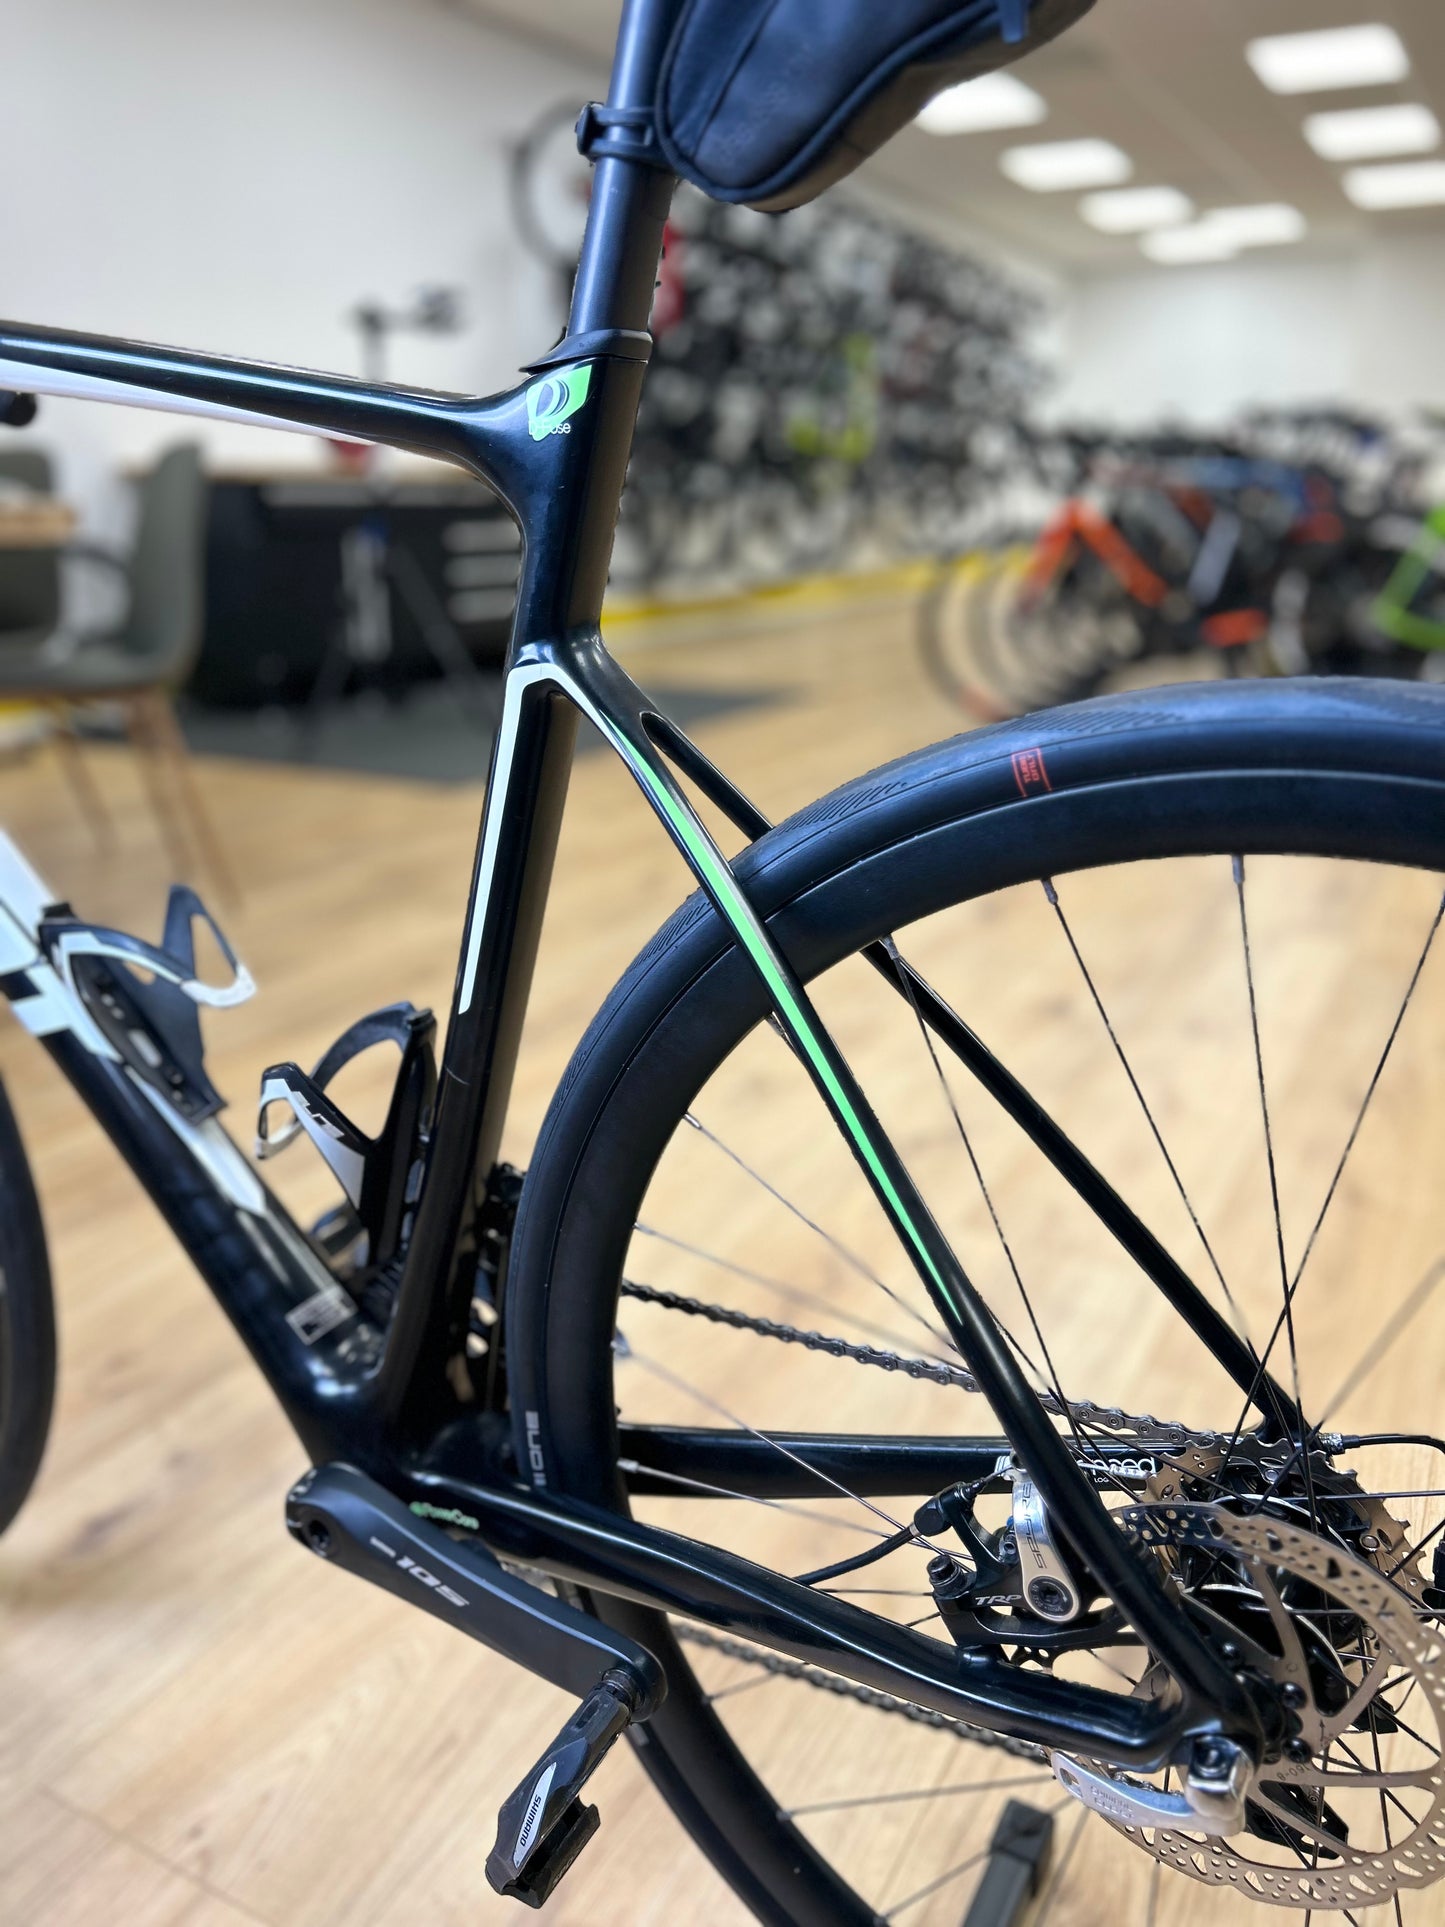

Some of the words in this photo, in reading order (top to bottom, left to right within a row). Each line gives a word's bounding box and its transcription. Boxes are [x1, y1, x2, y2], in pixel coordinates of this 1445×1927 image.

[396, 1555, 470, 1607] 105
[975, 1594, 1023, 1606] TRP
[520, 1795, 542, 1847] SHIMANO
